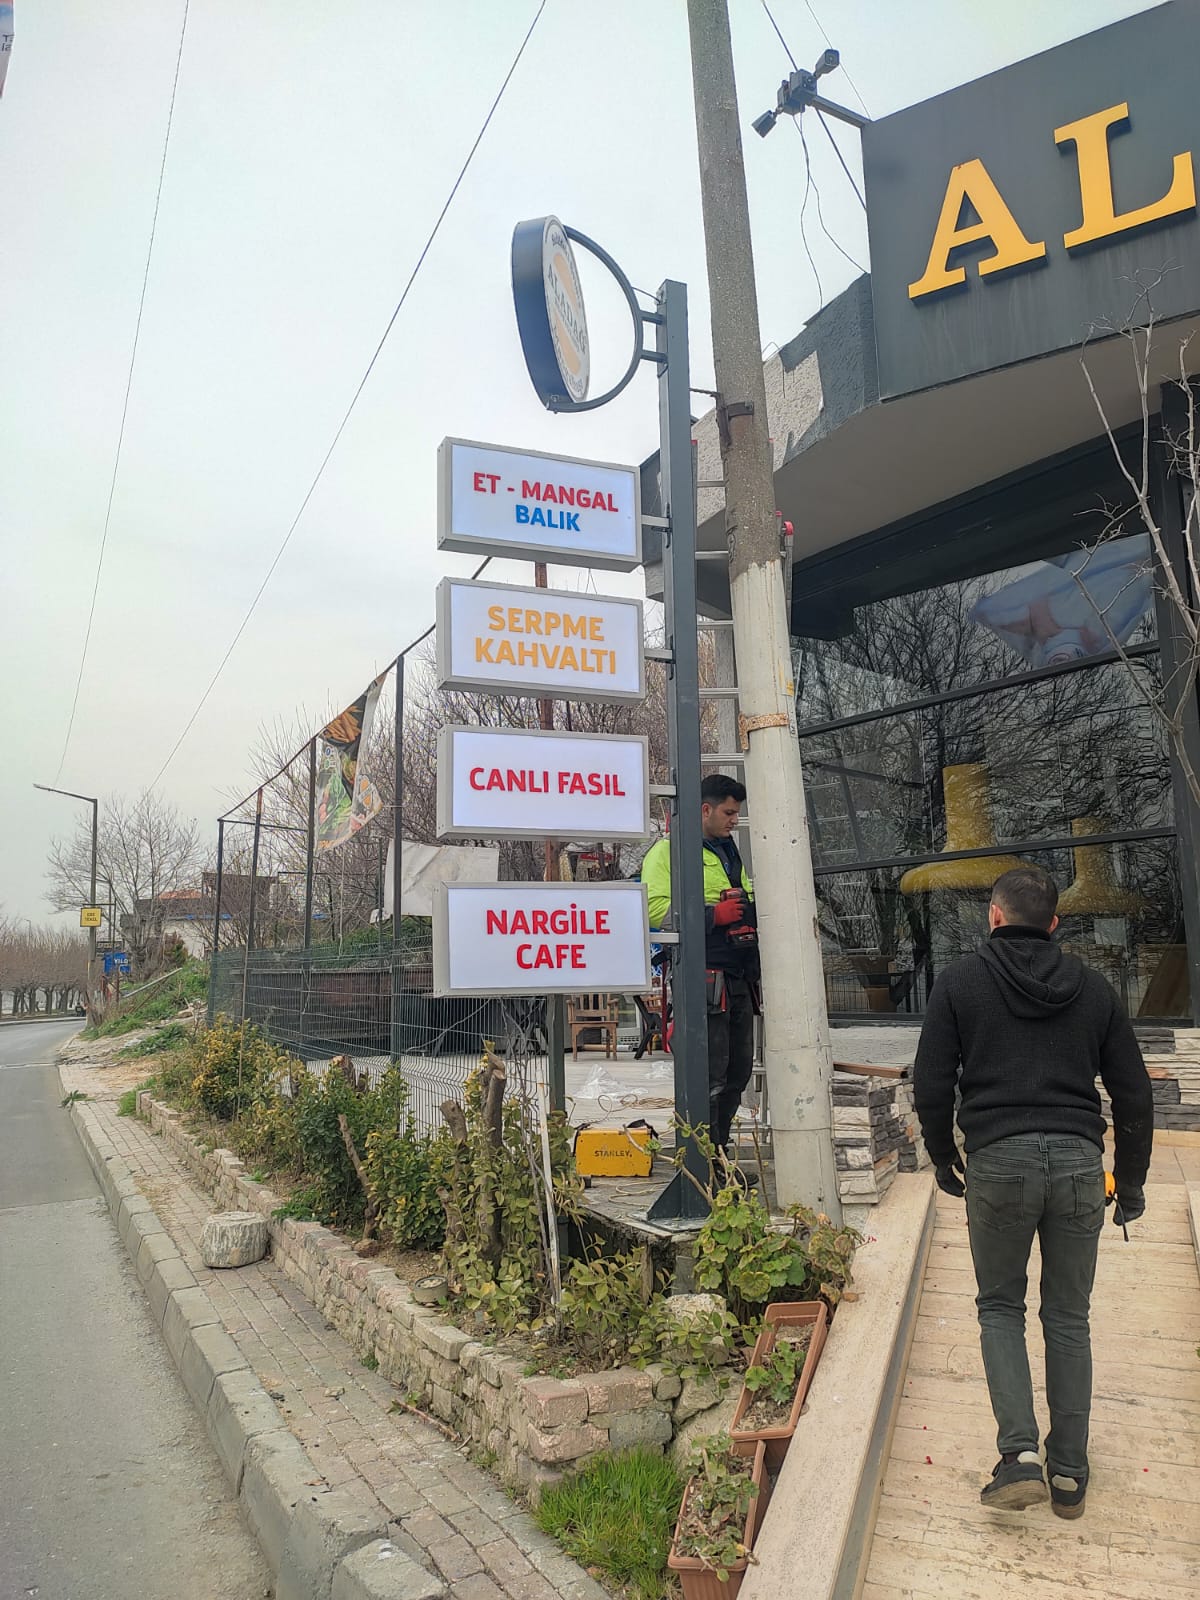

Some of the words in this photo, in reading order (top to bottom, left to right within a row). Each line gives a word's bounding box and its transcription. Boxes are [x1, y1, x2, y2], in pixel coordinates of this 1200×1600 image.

[908, 102, 1197, 299] AL
[473, 472, 501, 493] ET
[521, 480, 618, 512] MANGAL
[515, 504, 580, 532] BALIK
[488, 606, 604, 642] SERPME
[475, 637, 616, 674] KAHVALTI
[469, 767, 549, 793] CANLI
[558, 772, 625, 796] FASIL
[486, 903, 610, 935] NARGİLE
[516, 944, 586, 969] CAFE
[594, 1150, 630, 1158] STANLEY
